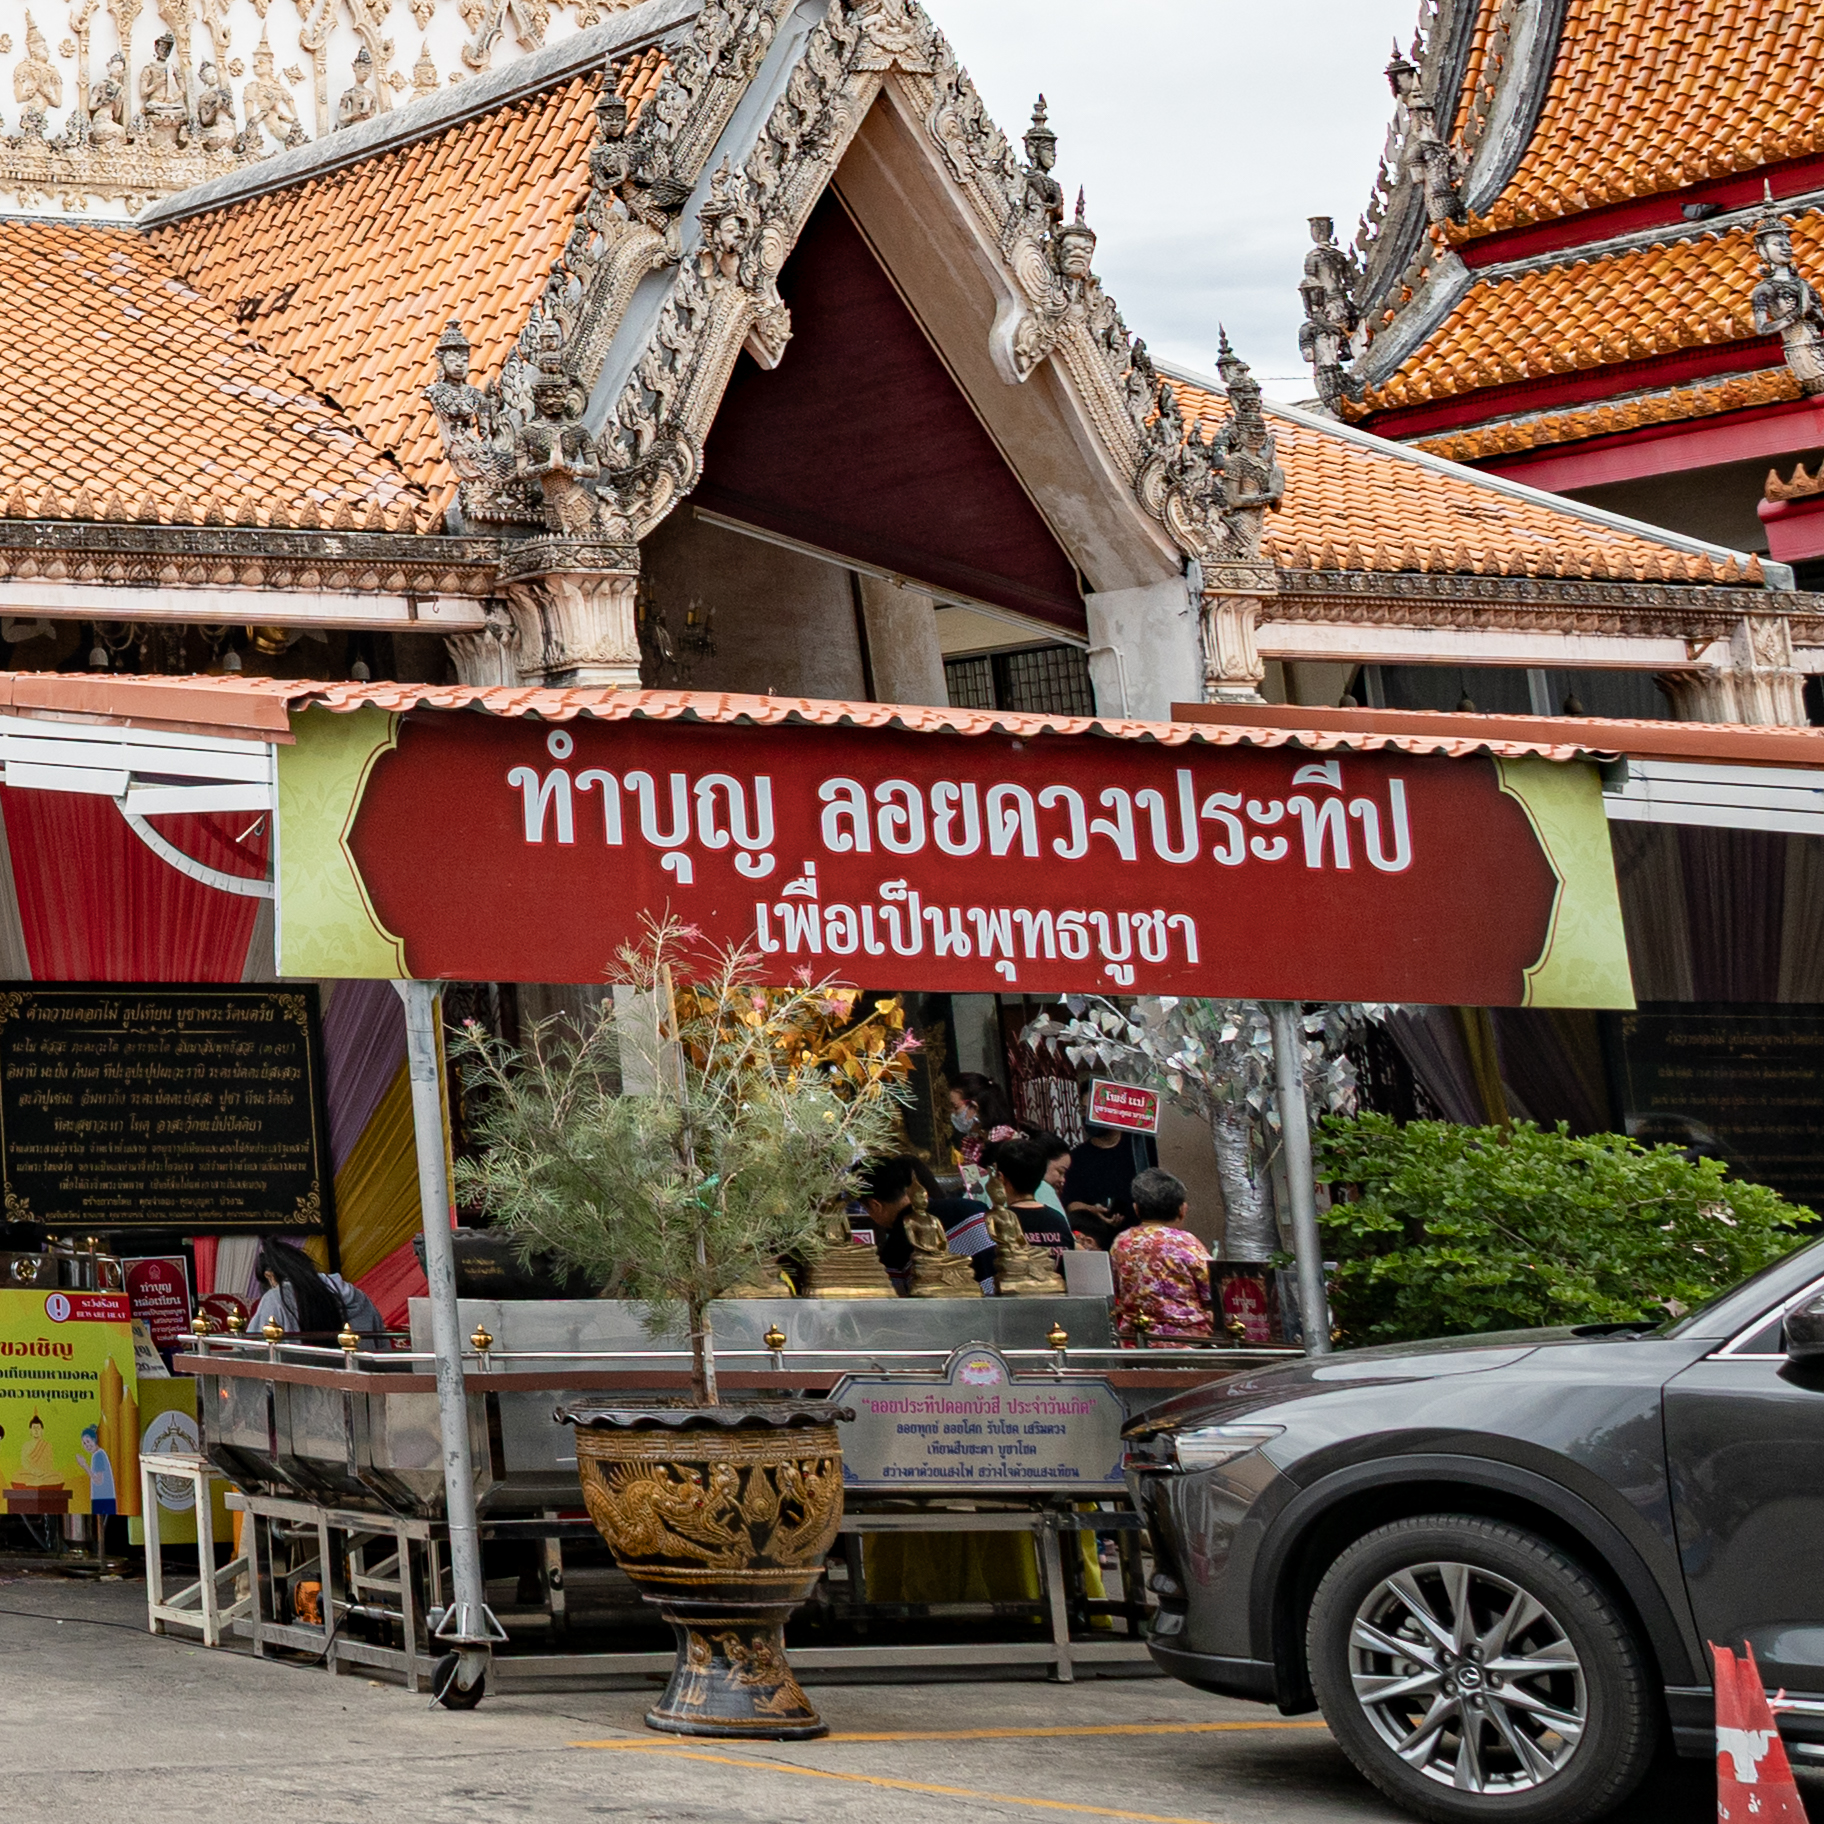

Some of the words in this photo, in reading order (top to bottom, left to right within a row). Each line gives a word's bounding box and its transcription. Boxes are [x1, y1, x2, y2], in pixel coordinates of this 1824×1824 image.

[507, 730, 780, 885] ทำบุญ
[819, 760, 1413, 875] ลอยดวงประทีป
[755, 861, 1200, 987] เพื่อเป็นพุทธบูชา
[25, 1000, 118, 1023] คำถวายดอกไม้
[122, 1003, 172, 1029] ธูปเทียน
[176, 1003, 274, 1030] บูชาพระรัตนตรัย
[1041, 1232, 1061, 1243] YOU
[139, 1281, 172, 1295] ทำบุญ
[0, 1337, 74, 1360] ขอเชิญ
[862, 1395, 1001, 1415] “ลอยประทีปดอกบัวสี
[1007, 1395, 1097, 1415] ประจำวันเกิด”
[897, 1421, 940, 1439] ลอยทุกข์
[943, 1419, 982, 1435] ลอยโศก
[987, 1419, 1020, 1435] รับโชค
[1023, 1421, 1066, 1435] เสริมดวง
[998, 1440, 1037, 1459] บูชาโชค
